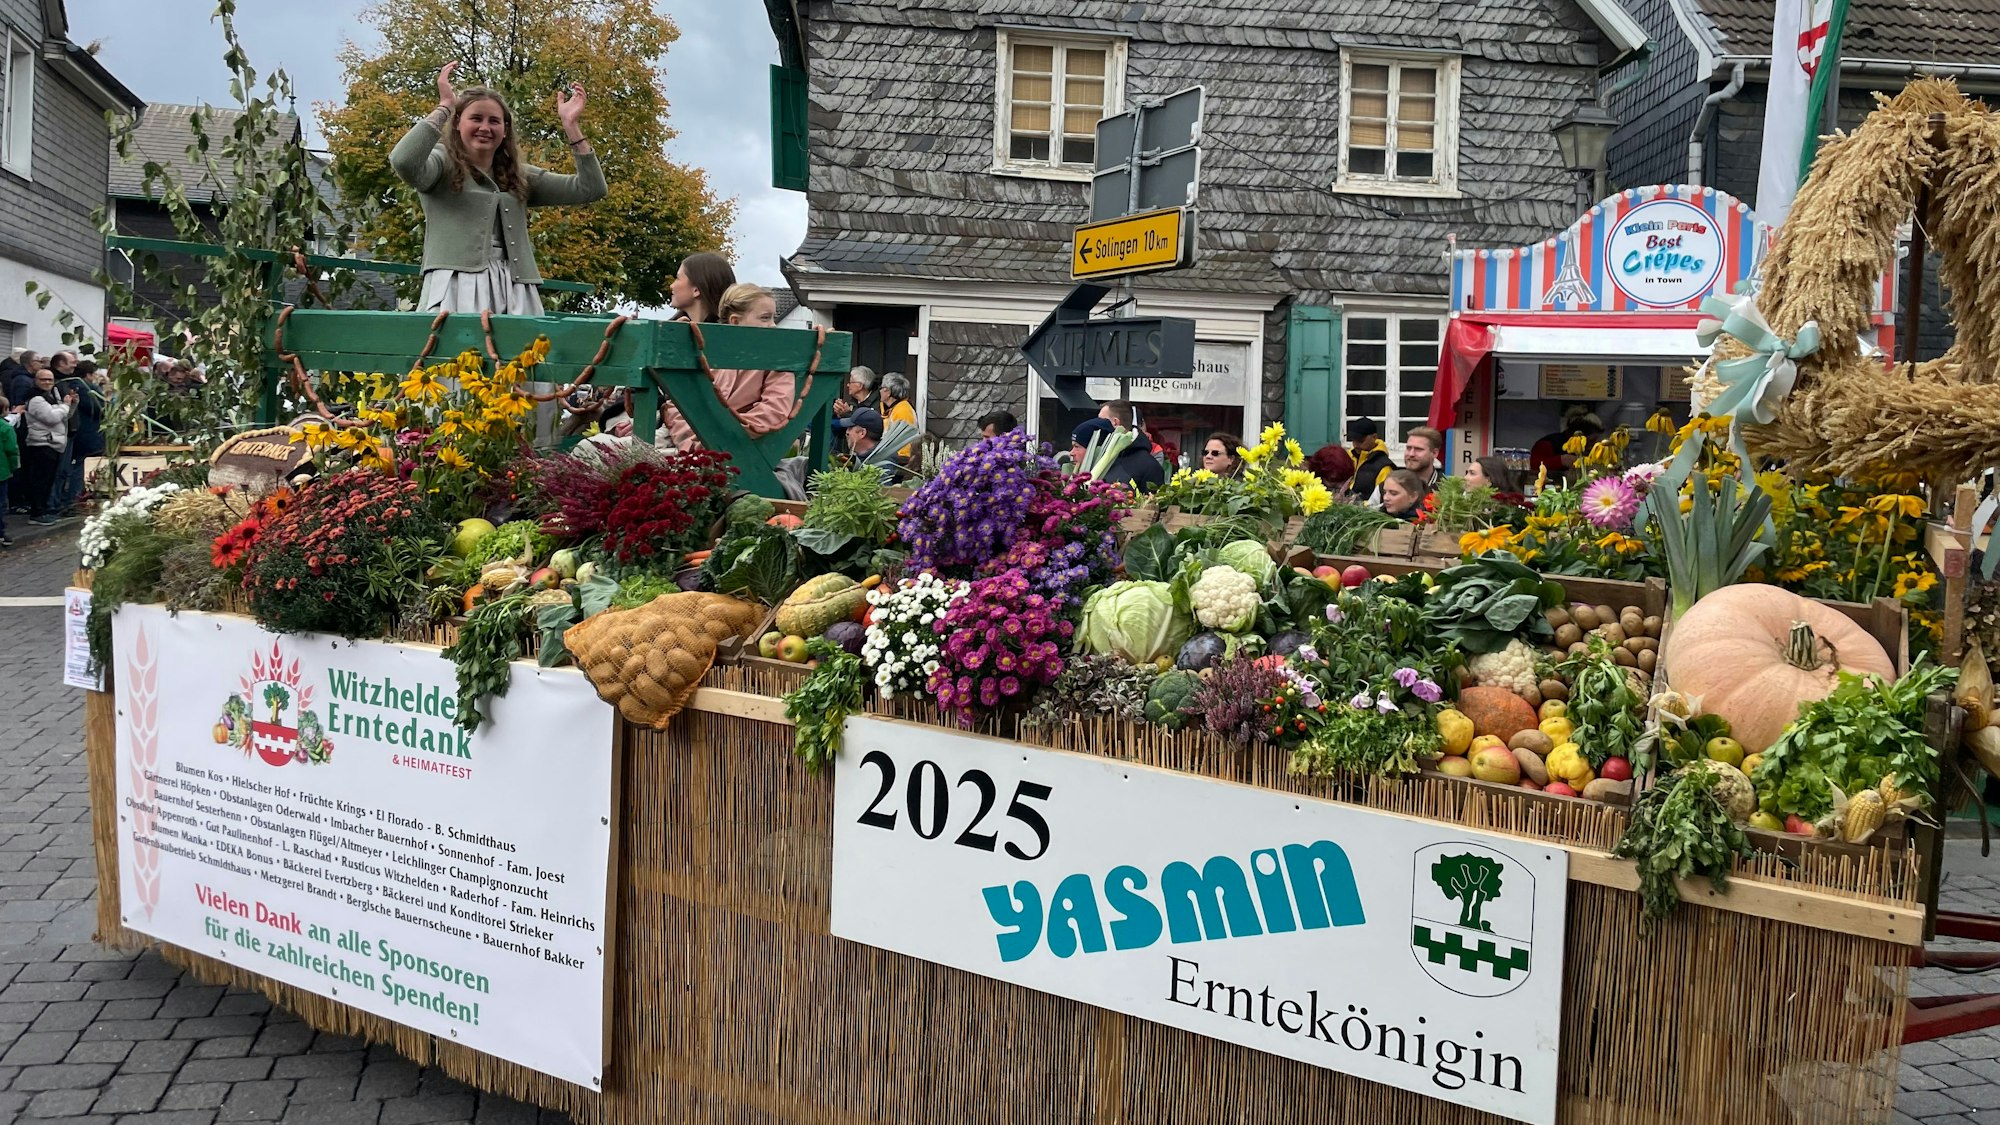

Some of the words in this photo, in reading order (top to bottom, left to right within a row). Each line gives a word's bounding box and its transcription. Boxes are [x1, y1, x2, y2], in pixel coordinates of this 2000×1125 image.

[1095, 236, 1138, 261] Solingen
[1624, 219, 1663, 236] Klein
[1667, 219, 1707, 235] Paris
[1645, 234, 1683, 250] Best
[1041, 329, 1163, 368] KIRMES
[1172, 381, 1201, 390] GmbH
[1192, 359, 1230, 374] shaus
[328, 667, 460, 721] Witzhelde
[328, 702, 473, 760] Erntedank
[175, 761, 206, 778] Blumen
[207, 769, 224, 783] Kos
[231, 775, 272, 794] Hielscher
[274, 785, 291, 799] Hof
[299, 791, 334, 809] Früchte
[336, 799, 366, 819] Krings
[375, 808, 385, 822] El
[387, 811, 424, 831] Florado
[434, 822, 445, 836] B.
[447, 826, 516, 853] Schmidthaus
[392, 753, 400, 765] &
[402, 755, 472, 780] HEIMATFEST
[857, 750, 1053, 860] 2025
[125, 796, 154, 814] Obsthof
[156, 806, 198, 827] Appenroth
[205, 819, 220, 834] Gut
[221, 824, 273, 847] Paulinenhof
[281, 839, 290, 852] L.
[293, 842, 332, 863] Raschad
[341, 855, 381, 876] Rusticus
[383, 866, 439, 892] Witzhelden
[449, 884, 499, 908] Raderhof
[511, 900, 537, 918] Fam.
[540, 907, 595, 932] Heinrichs
[153, 788, 194, 809] Bauernhof
[195, 800, 242, 822] Sesterhenn
[249, 814, 306, 839] Obstanlagen
[309, 829, 383, 858] Flügel/Altmeyer
[392, 850, 447, 876] Leichlinger
[449, 865, 548, 900] Champignonzucht
[180, 779, 211, 797] Höpken
[219, 789, 273, 813] Obstanlagen
[275, 803, 321, 824] Oderwald
[330, 816, 375, 837] Imbacher
[377, 827, 428, 851] Bauernhof
[437, 843, 495, 868] Sonnenhof
[506, 859, 532, 877] Fam.
[535, 866, 565, 884] Joest
[132, 831, 196, 860] Gartenbaubetrieb
[198, 851, 251, 876] Schmidthaus
[260, 869, 304, 891] Metzgerei
[306, 882, 337, 901] Brandt
[346, 893, 391, 917] Bergische
[394, 907, 472, 940] Bauernscheune
[482, 932, 541, 958] Bauernhof
[544, 948, 585, 970] Bakker
[150, 820, 179, 838] Blumen
[181, 829, 208, 847] Manka
[215, 839, 244, 857] EDEKA
[246, 848, 274, 865] Bonus
[282, 857, 322, 878] Bäckerei
[324, 868, 373, 896] Evertzberg
[382, 885, 424, 907] Bäckerei
[426, 900, 447, 914] und
[449, 903, 506, 930] Konditorei
[509, 919, 554, 941] Strieker
[195, 883, 249, 918] Vielen
[255, 901, 302, 935] Dank
[307, 923, 331, 944] an
[336, 929, 371, 957] alle
[378, 939, 489, 994] Sponsoren
[204, 916, 229, 941] für
[234, 927, 261, 953] die
[267, 942, 375, 991] zahlreichen
[381, 973, 479, 1026] Spenden!
[1165, 955, 1526, 1094] Erntekönigin
